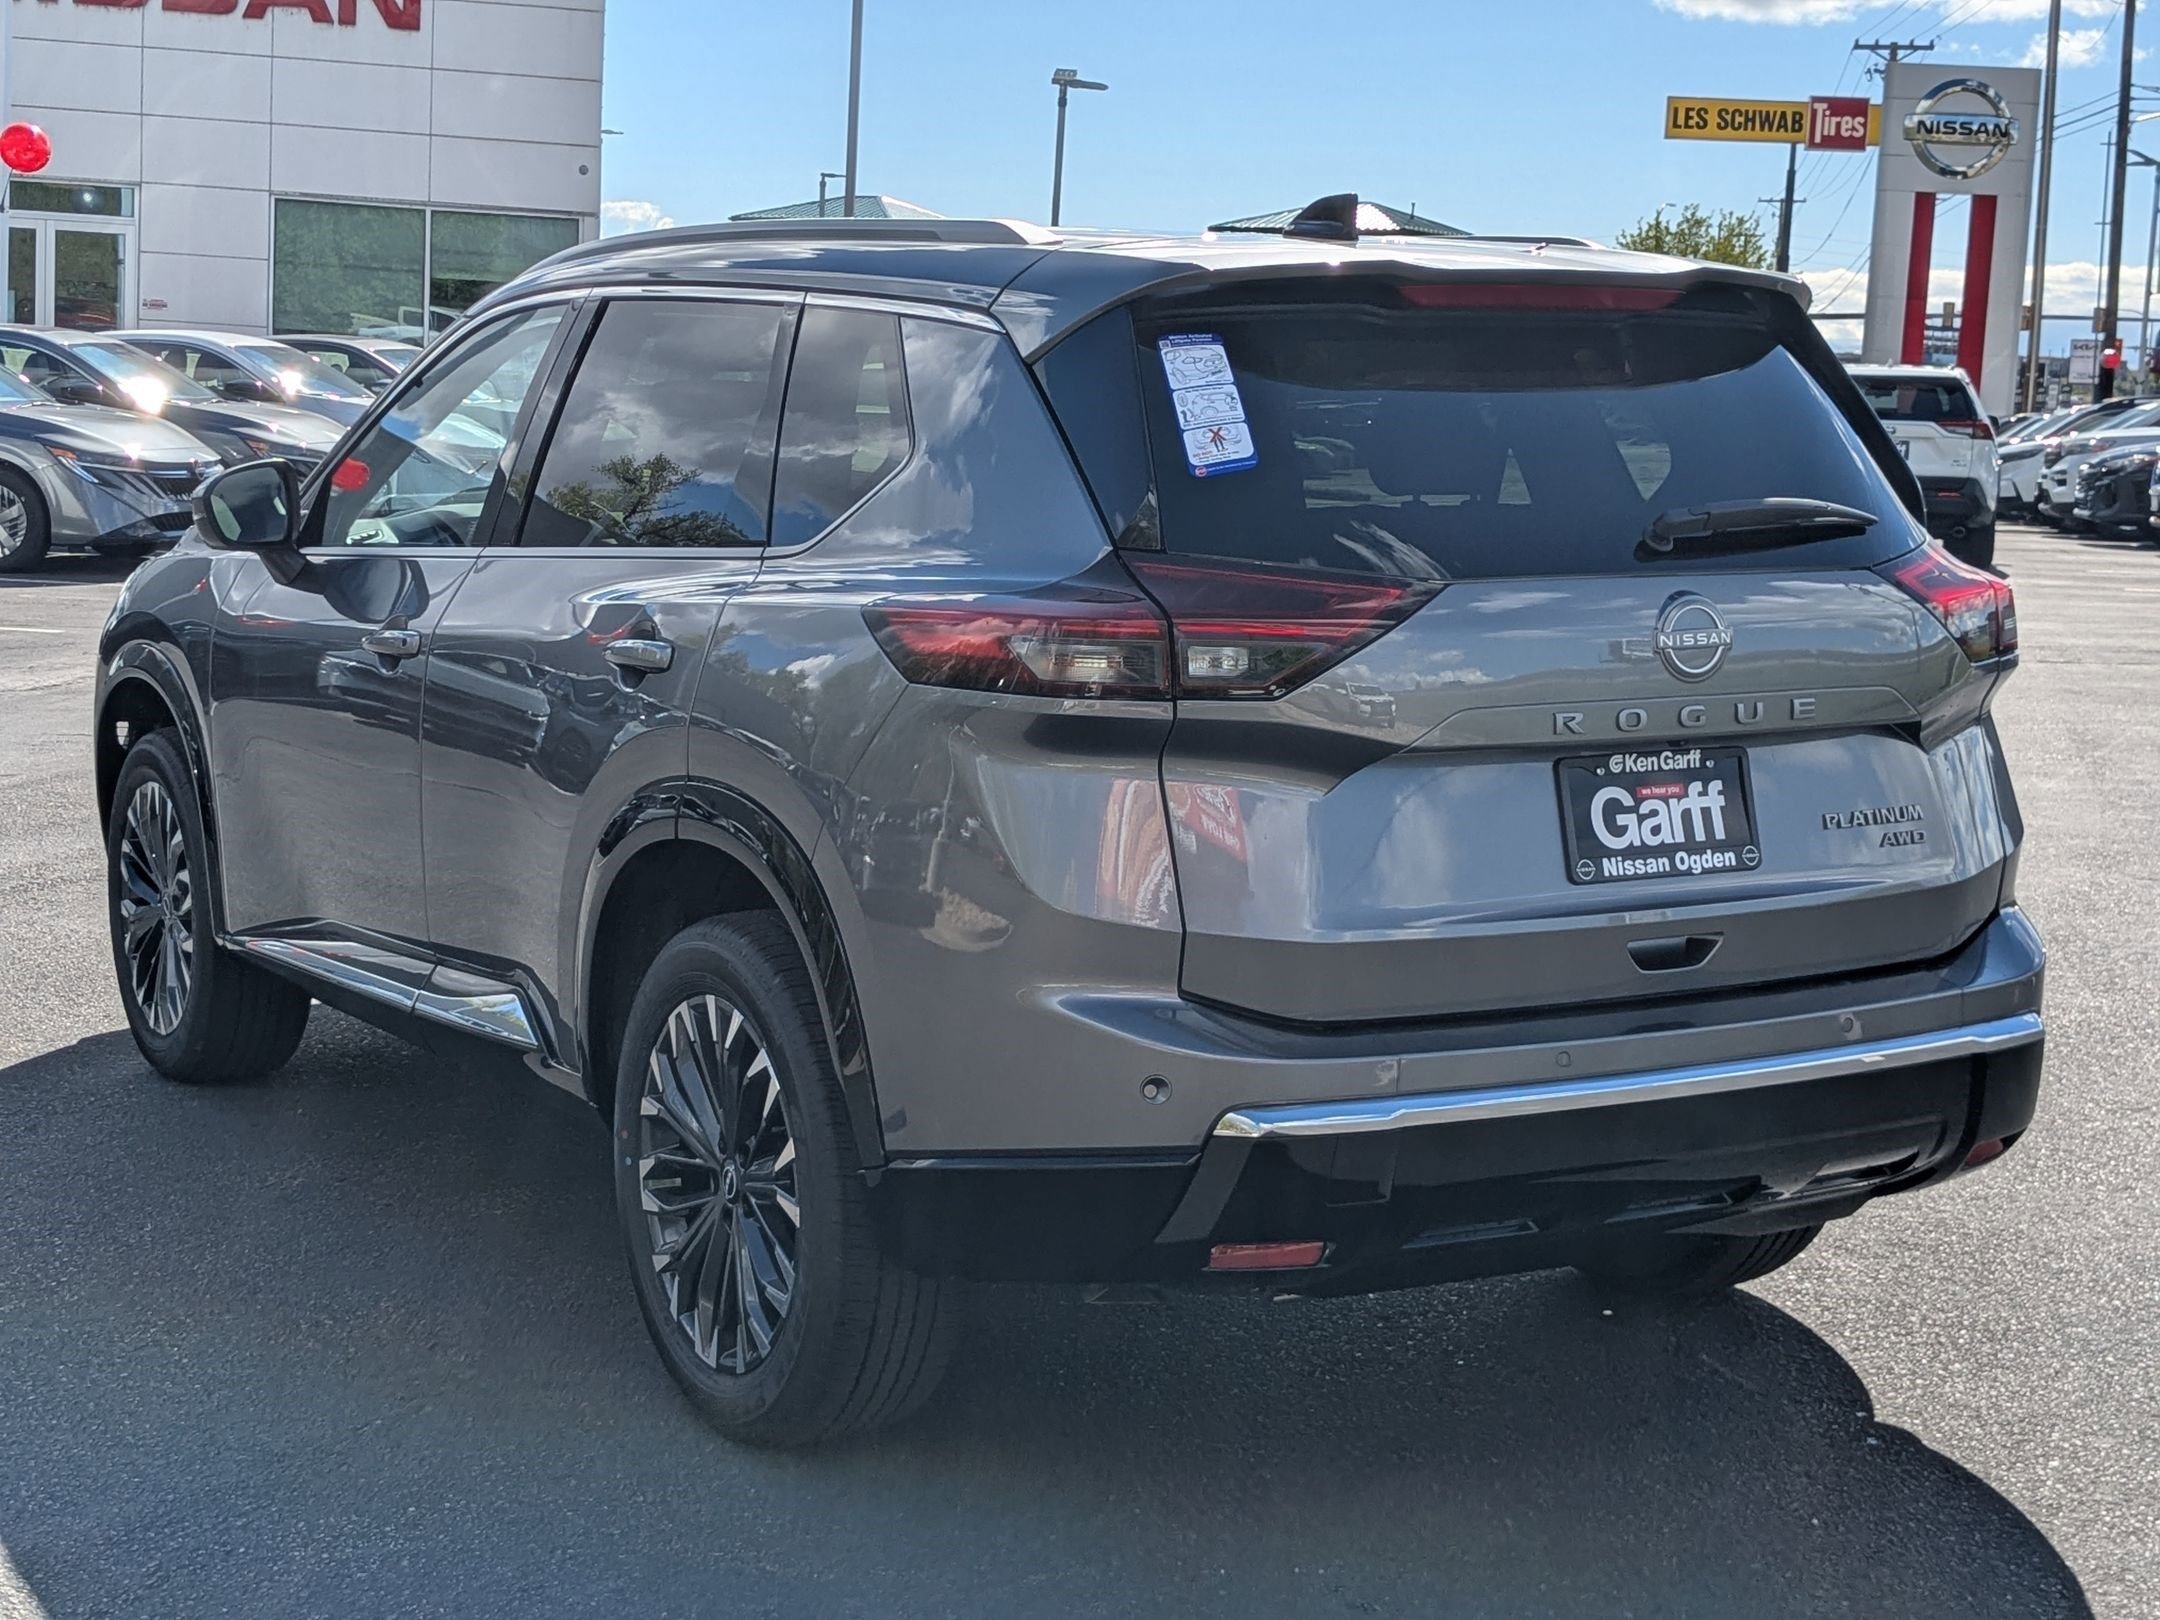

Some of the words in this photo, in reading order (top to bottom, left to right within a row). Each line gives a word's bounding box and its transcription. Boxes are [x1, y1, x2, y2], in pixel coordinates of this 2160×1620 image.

[1672, 106, 1708, 130] LES
[1716, 107, 1804, 133] SCHWAB
[1813, 102, 1866, 143] Tires
[1916, 119, 2010, 139] NISSAN
[1659, 631, 1732, 647] NISSAN
[1554, 697, 1816, 735] ROGUE
[1625, 753, 1659, 773] Ken
[1660, 749, 1702, 771] Garff
[1591, 780, 1726, 850] Garff
[1822, 804, 1924, 830] PLATINUM
[1879, 830, 1926, 848] AWD
[1602, 856, 1671, 877] Nissan
[1675, 849, 1737, 875] Ogden
